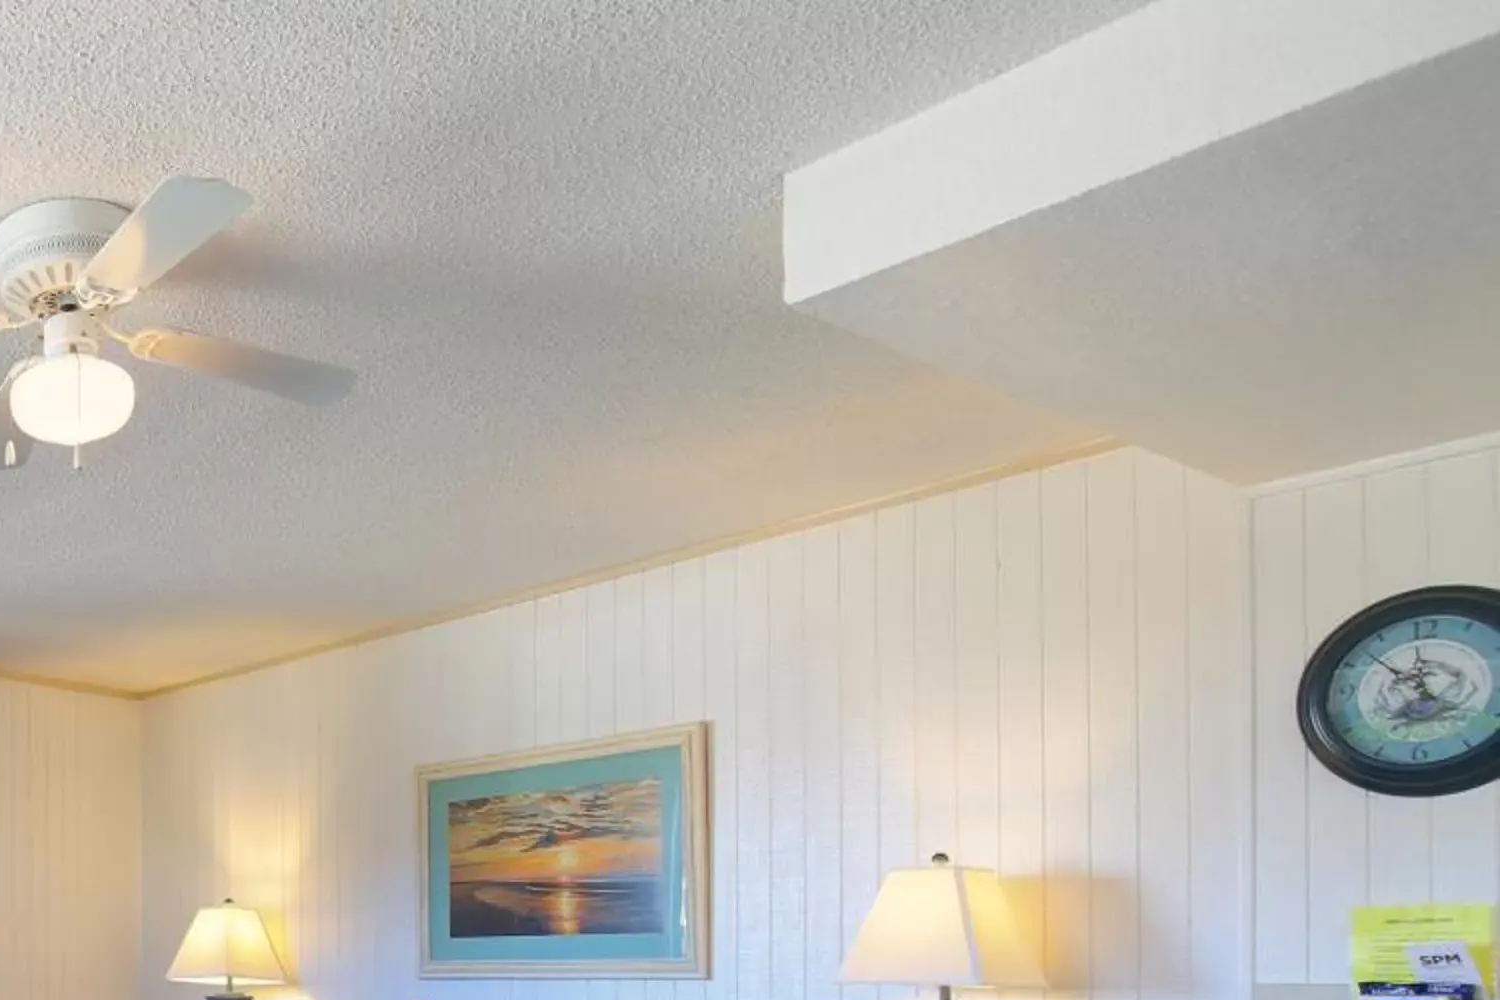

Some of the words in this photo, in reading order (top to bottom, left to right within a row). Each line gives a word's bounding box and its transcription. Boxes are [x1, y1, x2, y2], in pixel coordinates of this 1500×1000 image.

[1414, 619, 1438, 640] 12
[1411, 743, 1428, 761] 6
[1419, 952, 1461, 966] SPM
